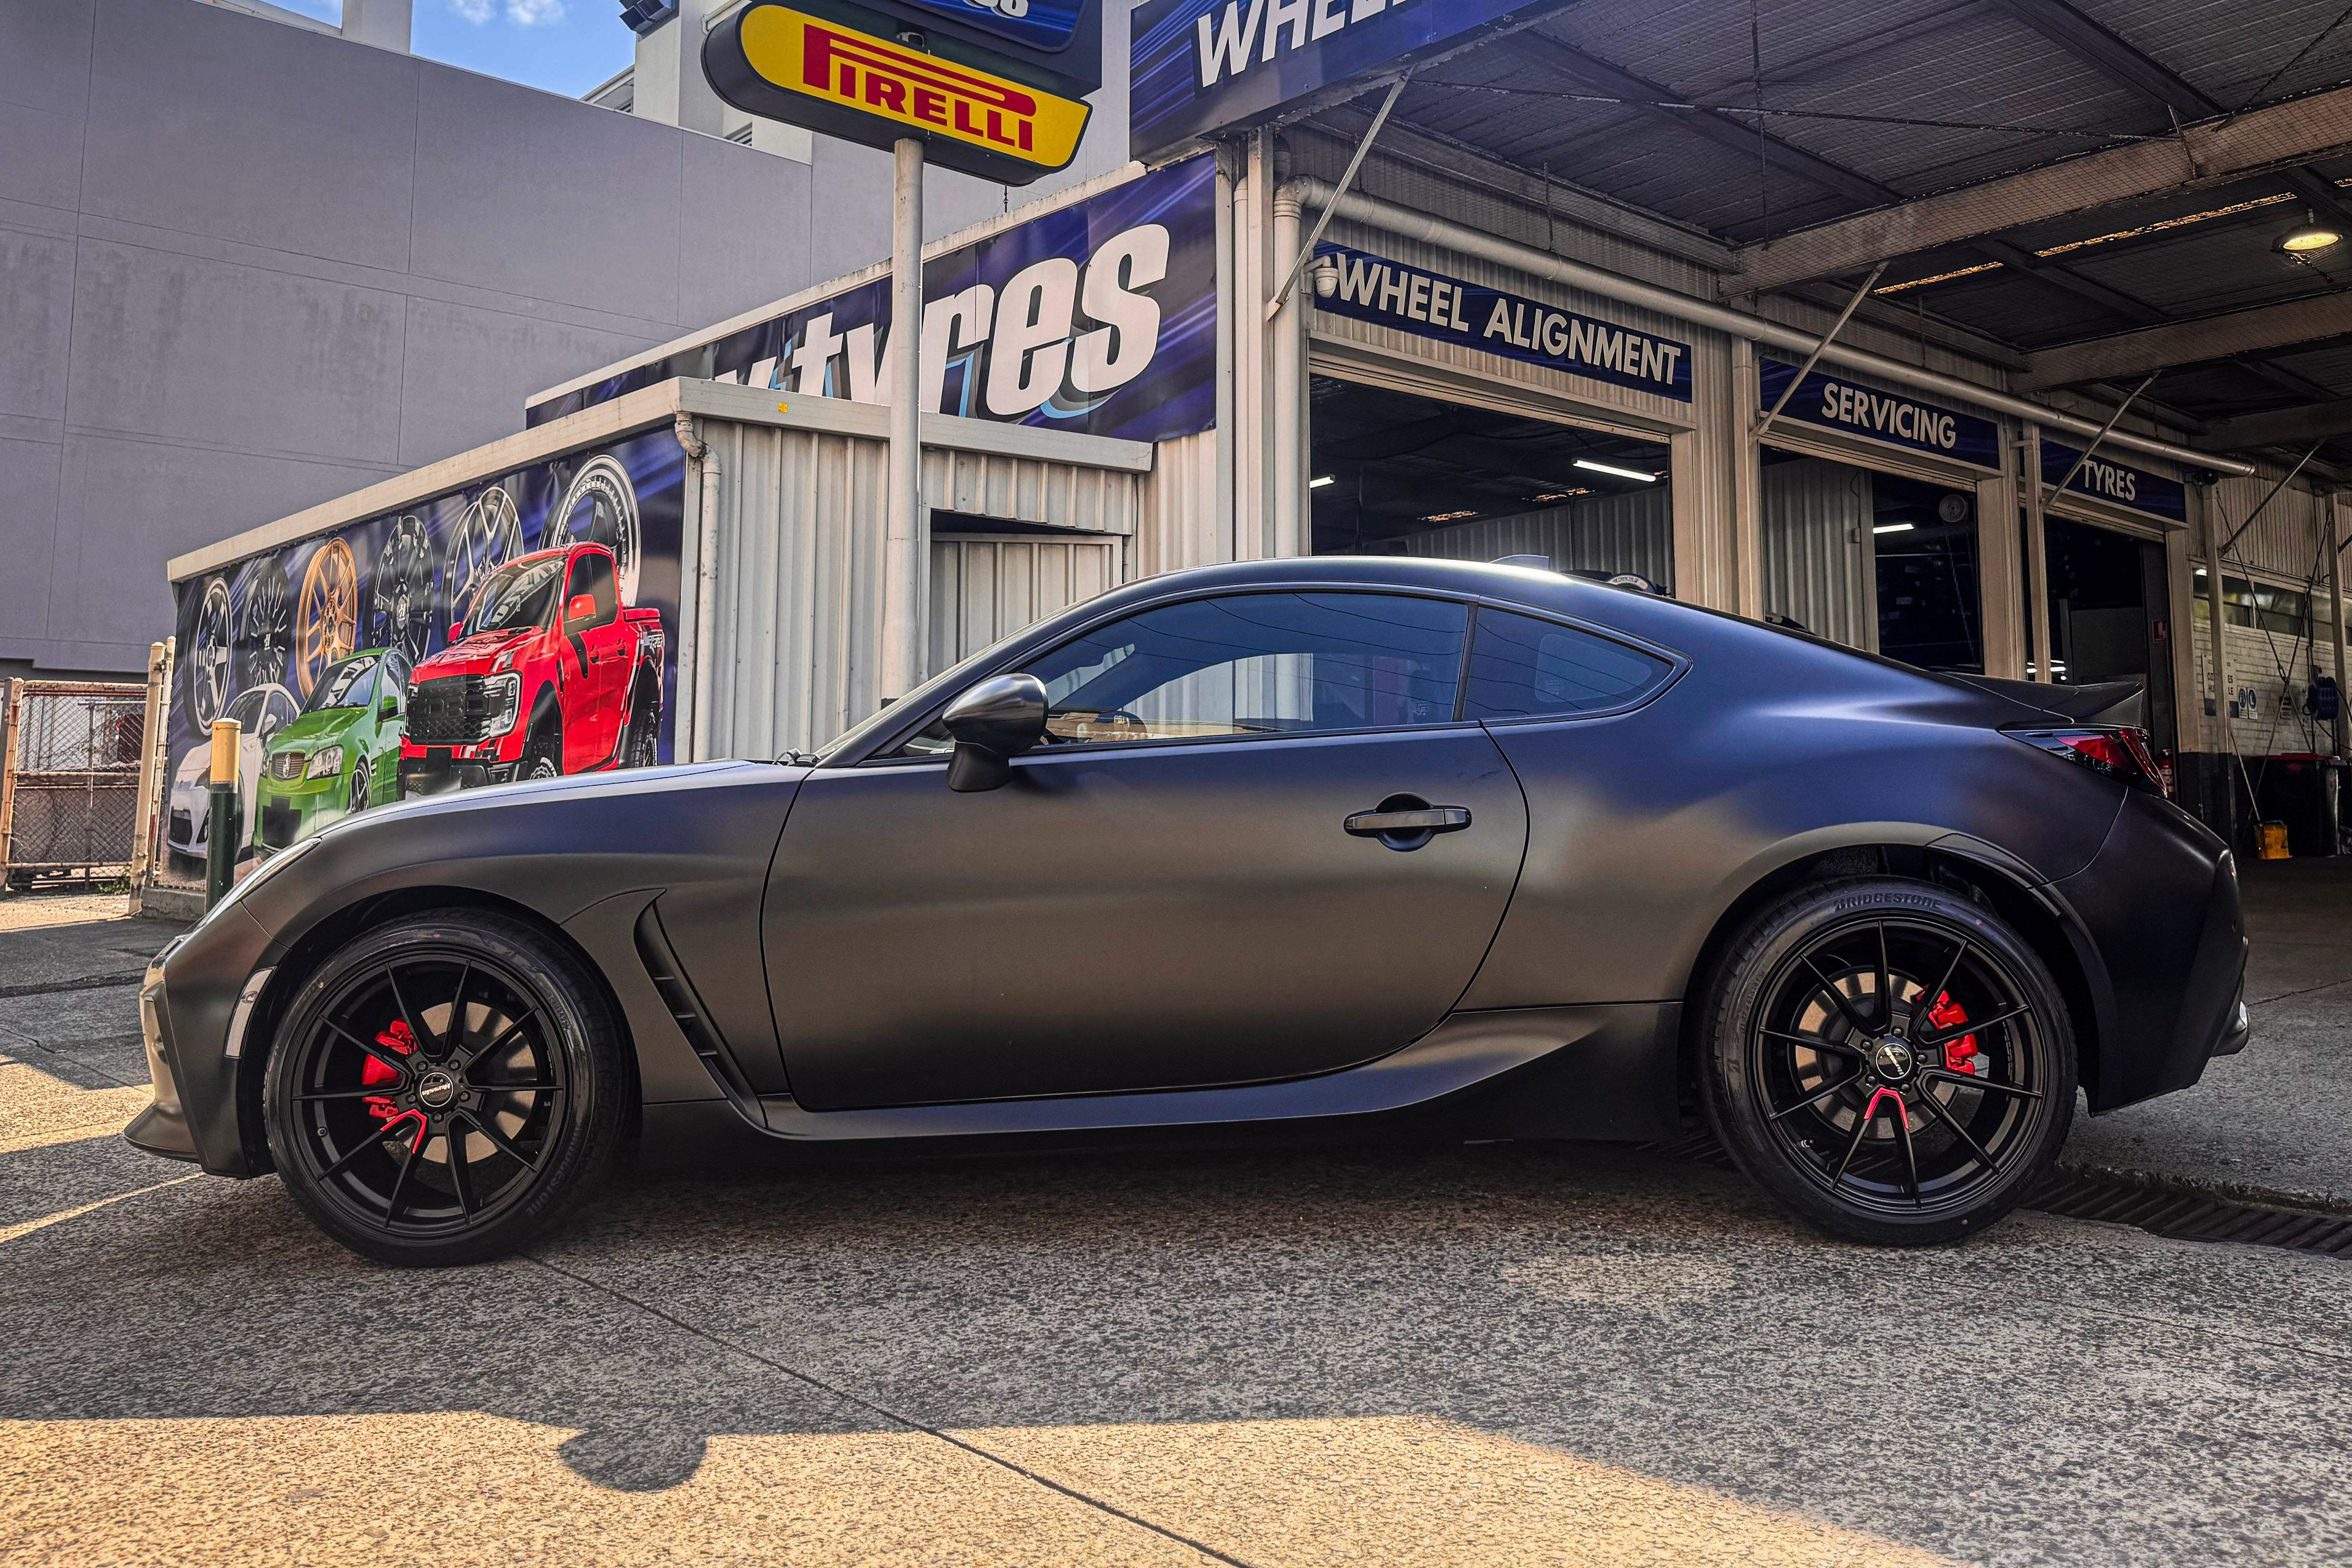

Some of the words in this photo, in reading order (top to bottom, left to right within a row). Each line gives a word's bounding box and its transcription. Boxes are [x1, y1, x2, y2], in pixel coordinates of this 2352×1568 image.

[1197, 0, 1409, 88] WHE
[803, 23, 1037, 152] PIRELLI
[1336, 252, 1469, 333] WHEEL
[1483, 298, 1681, 385] ALIGNMENT
[1822, 383, 1956, 449] SERVICING
[2082, 459, 2136, 502] TYRES
[1833, 892, 1942, 912] BRIDGESTONE
